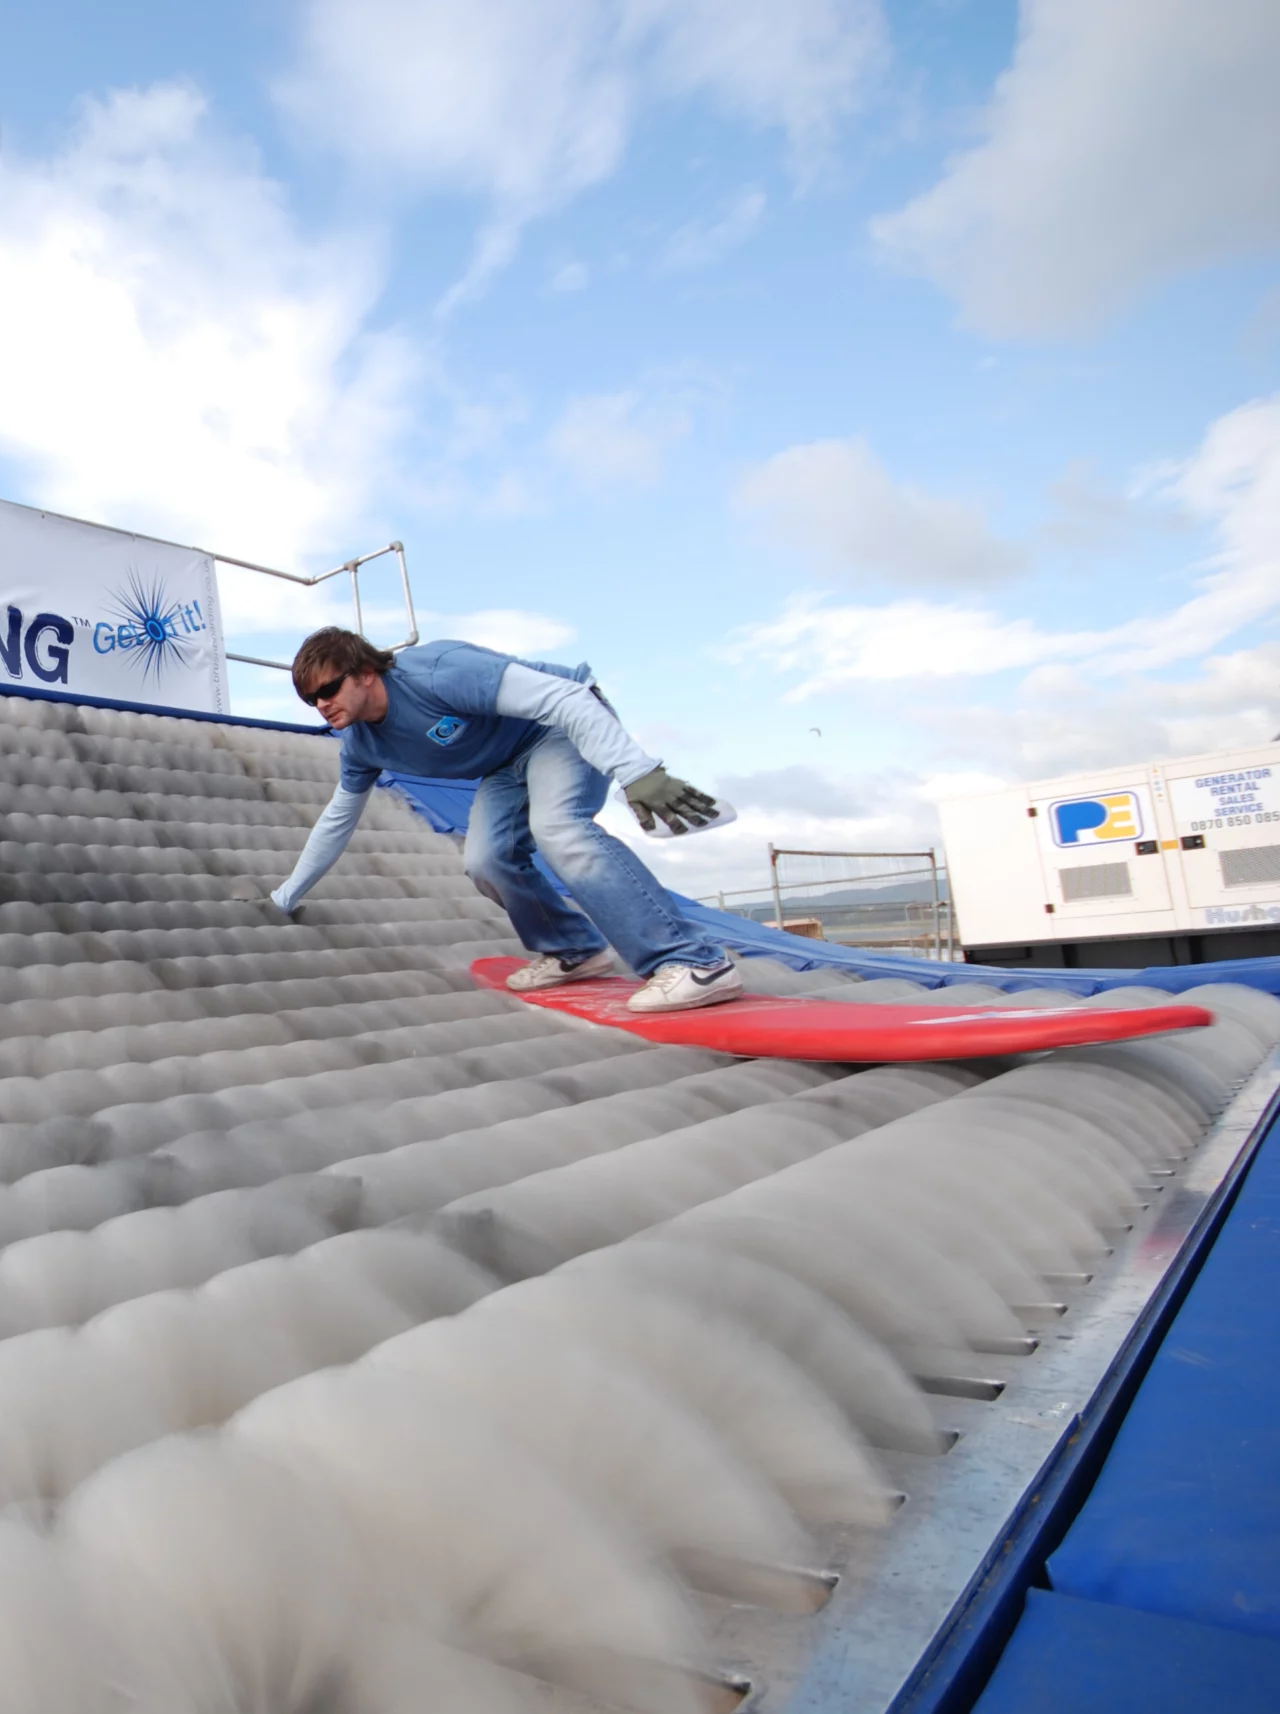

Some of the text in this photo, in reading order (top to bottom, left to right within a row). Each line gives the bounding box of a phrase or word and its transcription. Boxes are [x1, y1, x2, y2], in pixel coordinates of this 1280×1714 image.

[93, 619, 144, 654] Get
[177, 600, 207, 634] it!
[1195, 768, 1272, 788] GENERATOR
[1210, 781, 1261, 797] RENTAL
[1219, 793, 1255, 806] SALES
[1214, 802, 1264, 817] SERVICE
[1191, 818, 1223, 832] 0870
[1227, 814, 1252, 827] 850
